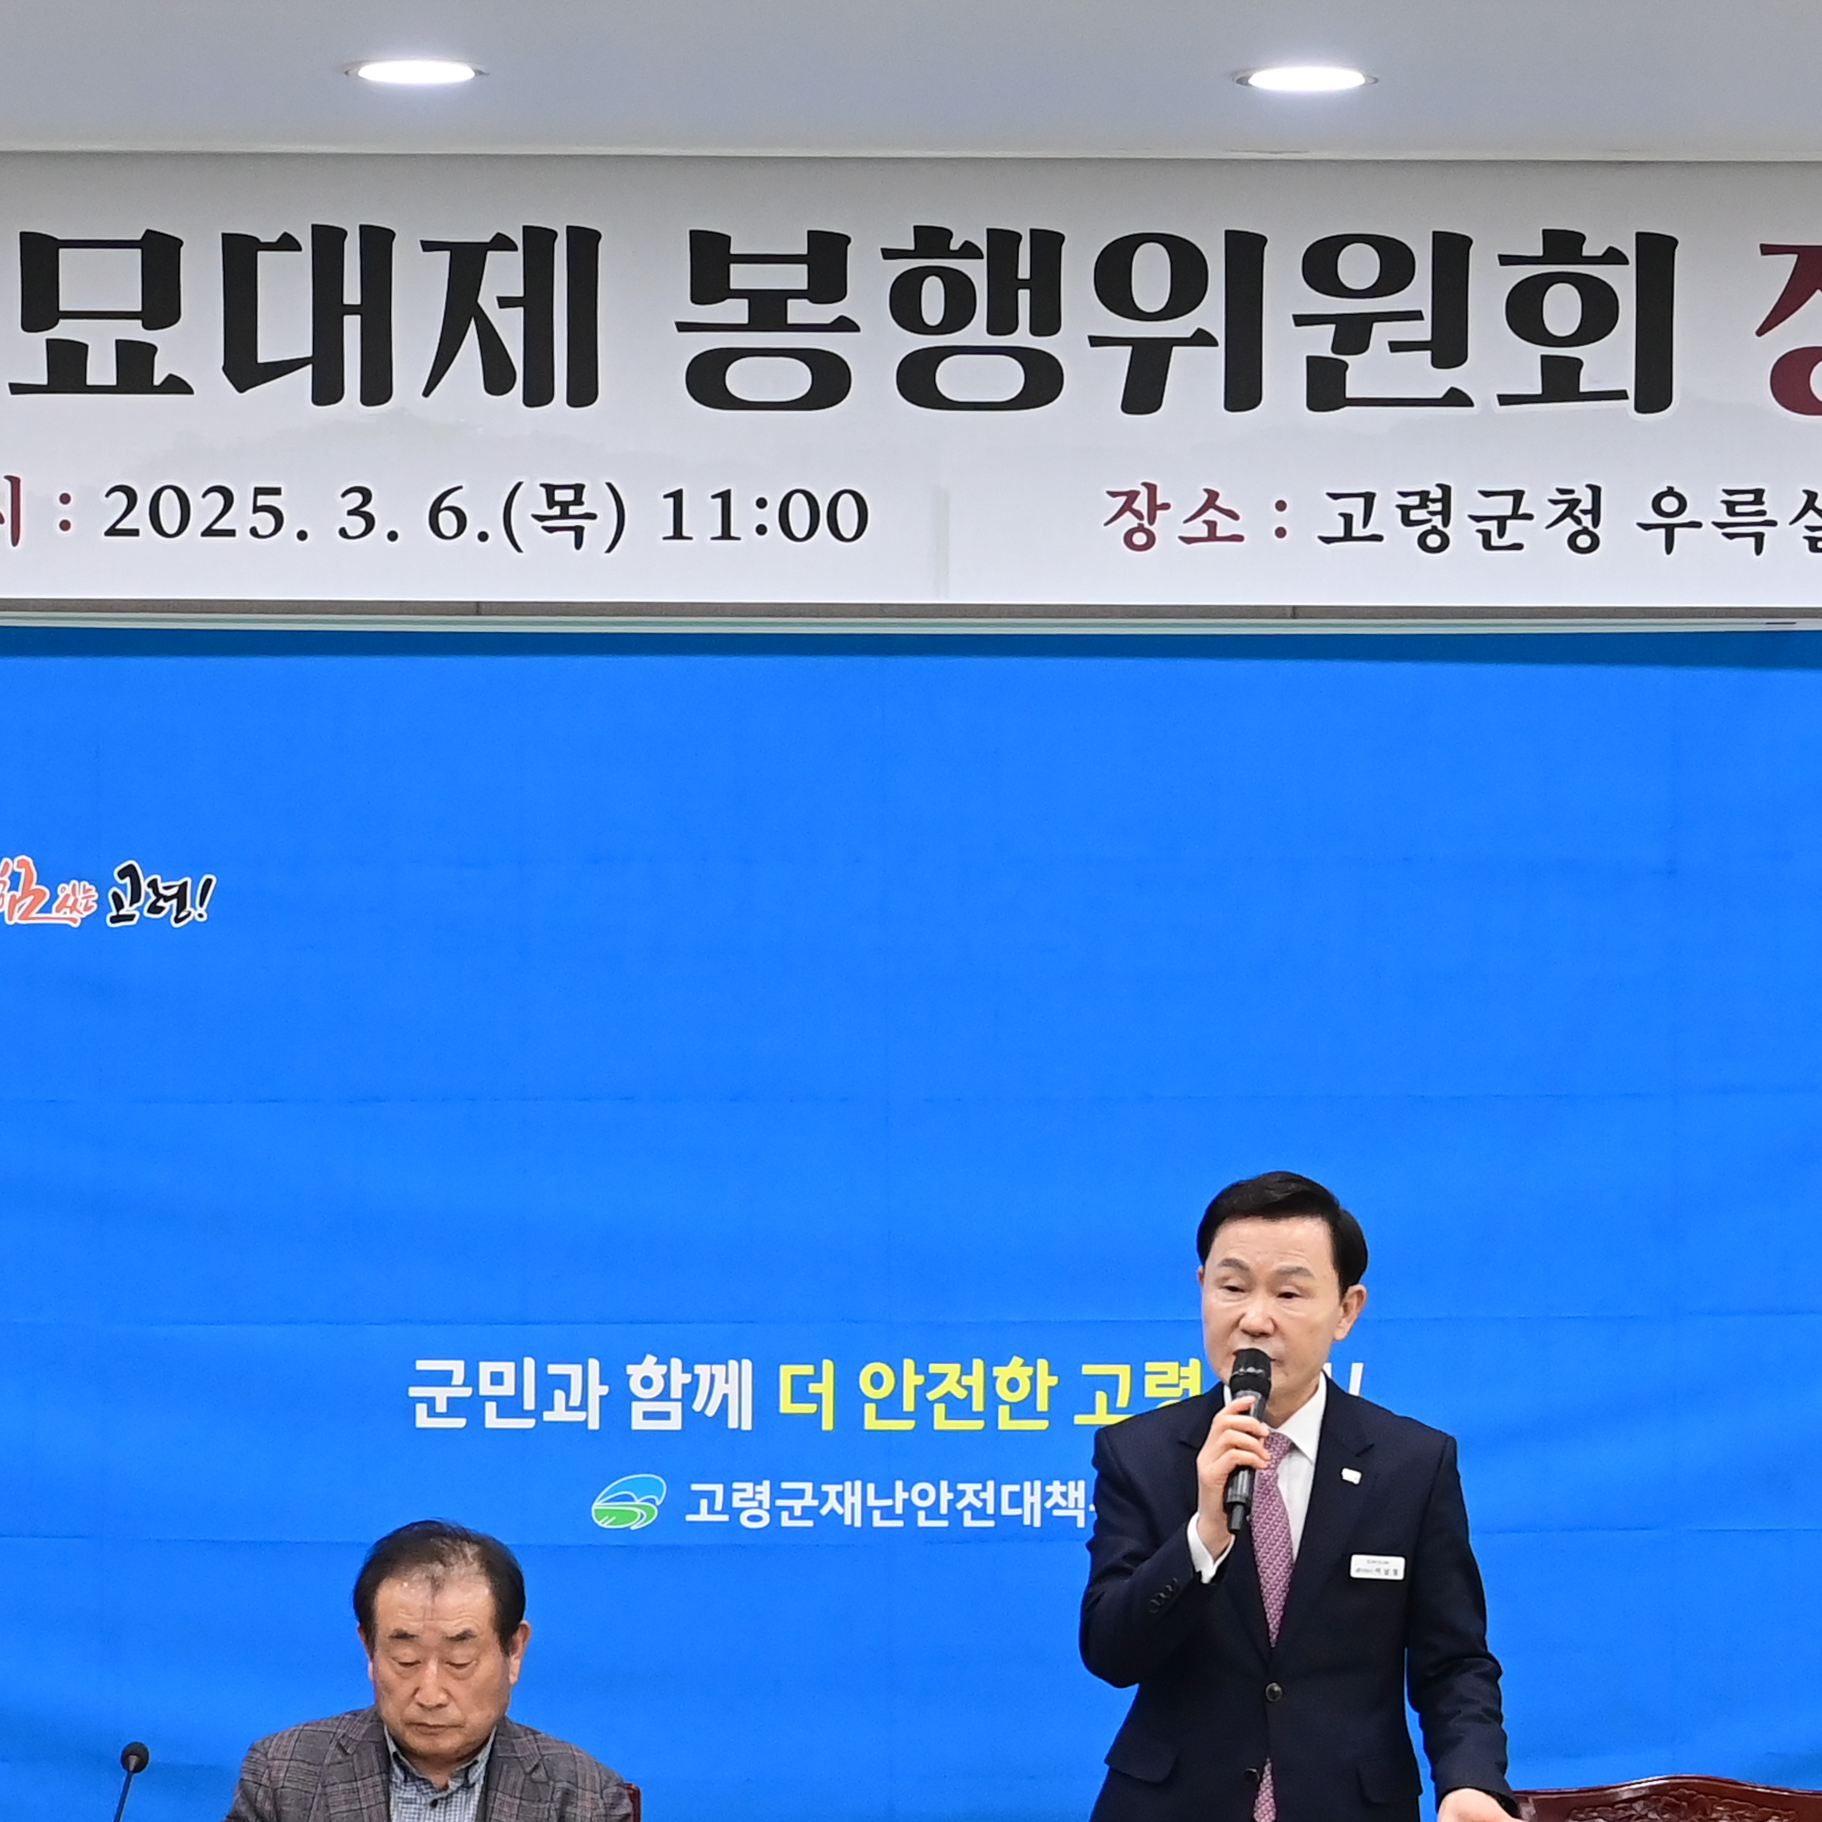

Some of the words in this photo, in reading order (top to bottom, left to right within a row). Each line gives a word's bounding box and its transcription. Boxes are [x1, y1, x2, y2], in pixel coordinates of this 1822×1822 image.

[675, 225, 1678, 415] 봉행위원회
[104, 485, 308, 541] 2025.
[339, 486, 398, 542] 3.
[429, 482, 625, 553] 6.(목)
[663, 489, 868, 542] 11:00
[1104, 482, 1244, 551] 장소
[1318, 483, 1601, 554] 고령군청
[408, 1357, 608, 1430] 군민과
[627, 1355, 752, 1430] 함께
[781, 1360, 835, 1430] 더
[861, 1357, 1059, 1430] 안전한
[685, 1481, 1096, 1528] 고령군재난안전대책
